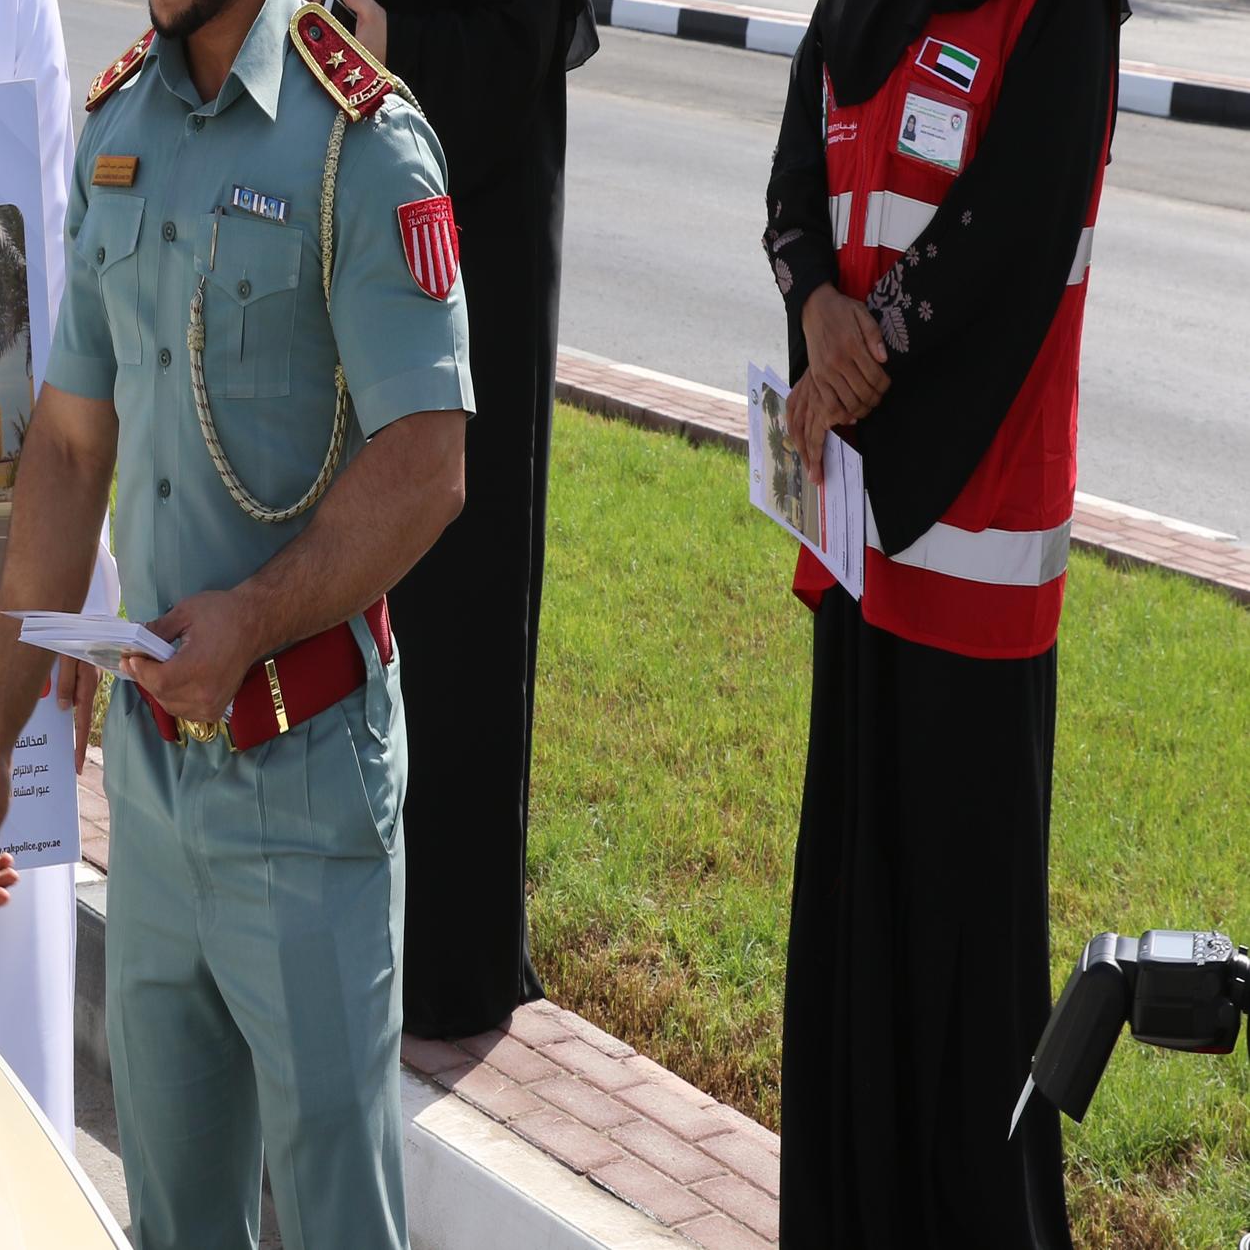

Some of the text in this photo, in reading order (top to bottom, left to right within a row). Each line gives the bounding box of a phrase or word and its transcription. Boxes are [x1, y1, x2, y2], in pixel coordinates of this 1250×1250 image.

[33, 764, 50, 779] عدم
[13, 786, 35, 798] المشاة
[35, 785, 51, 799] عبور
